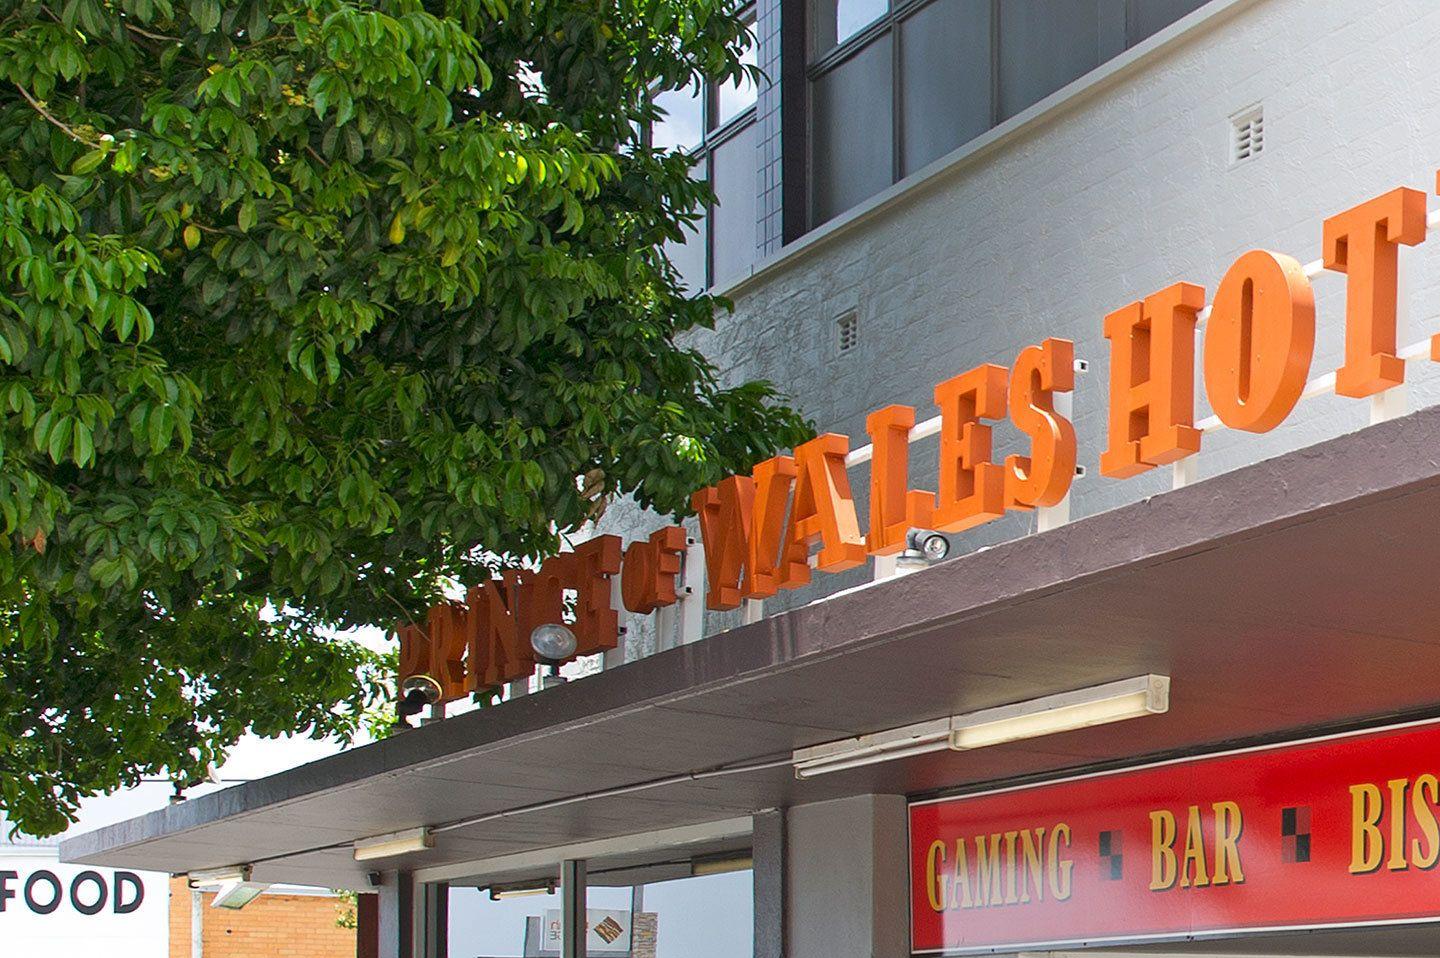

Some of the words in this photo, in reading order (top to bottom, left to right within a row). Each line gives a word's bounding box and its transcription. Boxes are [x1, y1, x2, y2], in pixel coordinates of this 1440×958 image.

[695, 336, 1078, 610] WALES
[0, 869, 145, 915] FOOD
[926, 822, 1074, 912] GAMING
[1149, 800, 1243, 891] BAR
